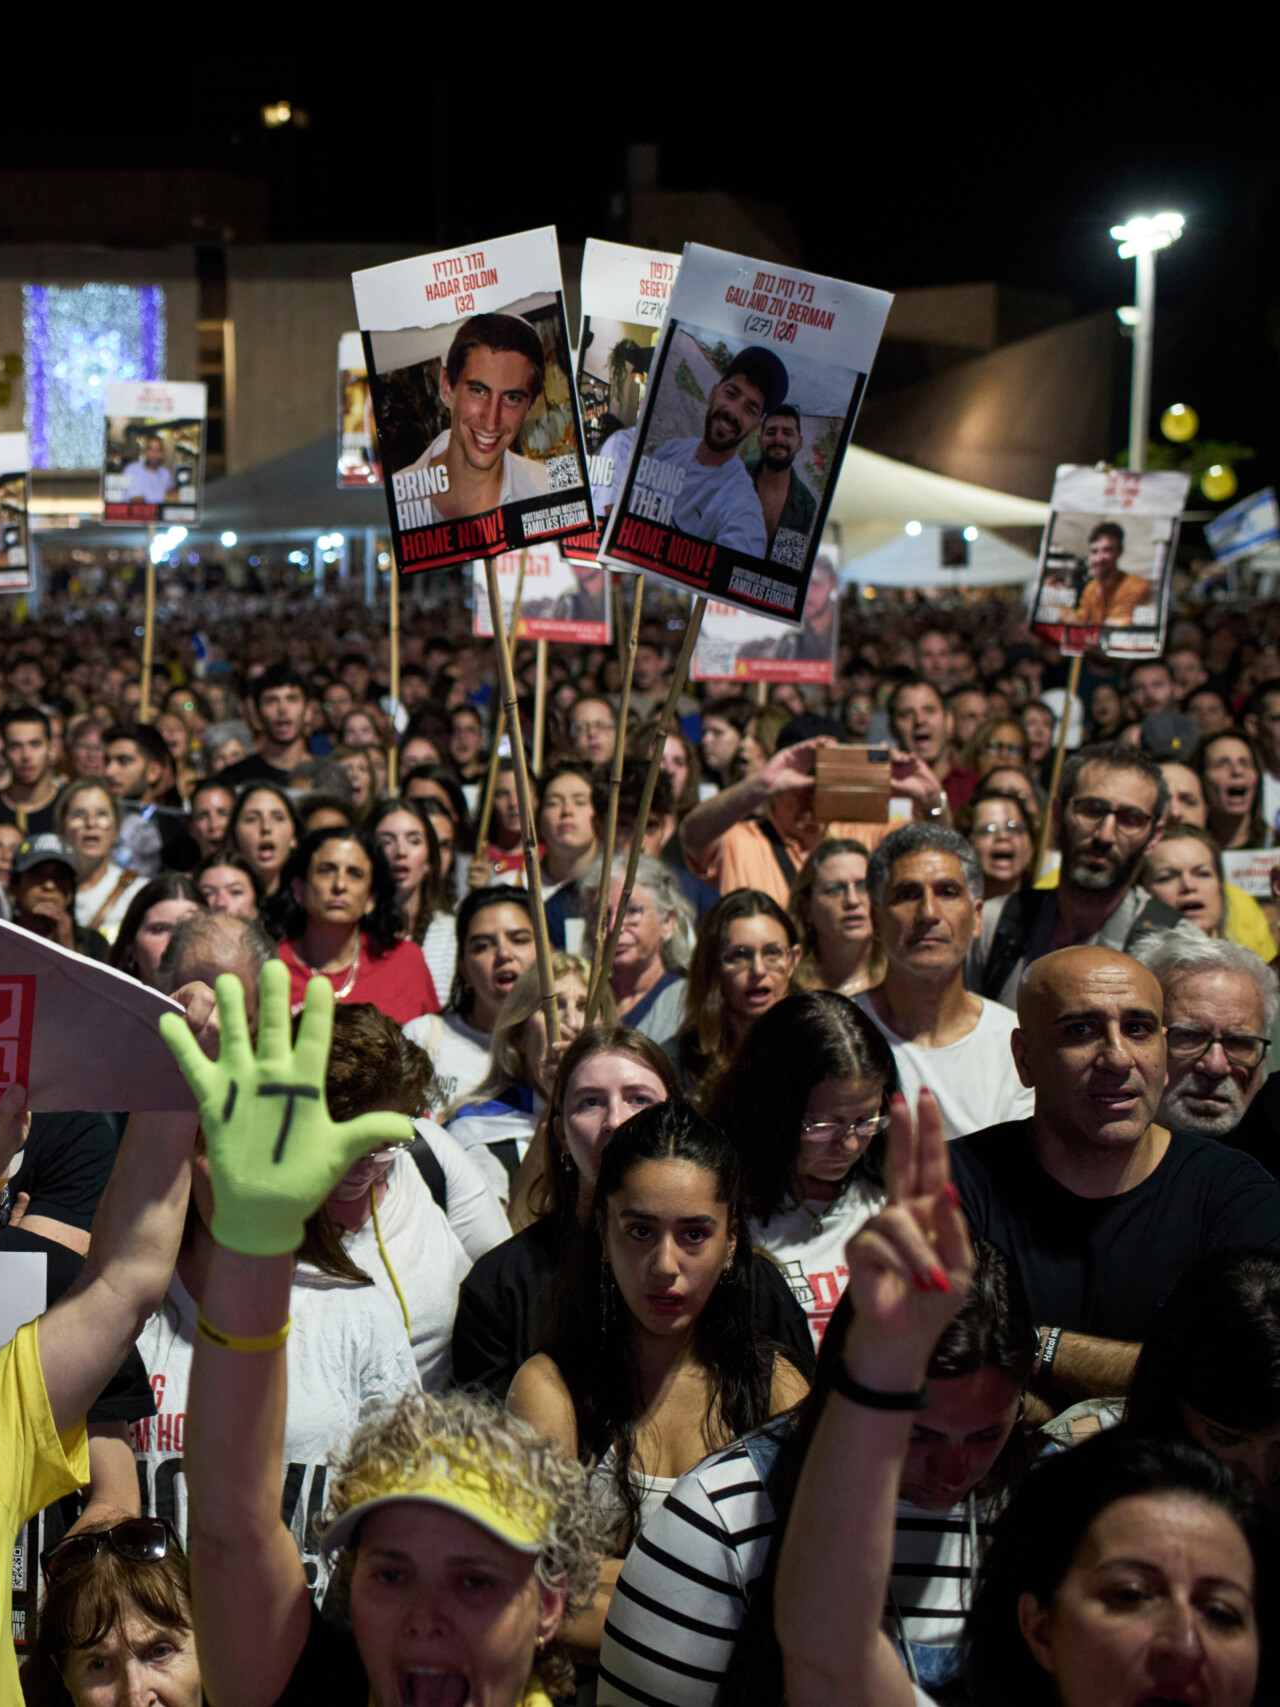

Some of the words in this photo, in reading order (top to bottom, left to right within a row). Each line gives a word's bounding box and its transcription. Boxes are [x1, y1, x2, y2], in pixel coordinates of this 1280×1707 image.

[432, 256, 463, 281] גולדין
[464, 252, 486, 271] הדר
[425, 273, 461, 301] HADAR
[463, 268, 498, 292] GOLDIN
[639, 278, 667, 299] SEGEV
[455, 292, 475, 315] (32)
[725, 285, 746, 308] GALI
[747, 291, 767, 313] AND
[767, 296, 788, 318] ZIV
[787, 301, 835, 331] BERMAN
[743, 313, 774, 335] (27)
[392, 464, 450, 503] BRING
[635, 454, 686, 497] BRING
[396, 498, 435, 532] HIM
[521, 507, 550, 523] HOSTAGES
[549, 504, 561, 516] AND
[561, 500, 587, 515] MISSING
[628, 484, 675, 527] THEM
[400, 525, 455, 563] HOME
[457, 508, 506, 550] NOW!
[523, 515, 559, 536] FAMILIES
[560, 510, 589, 530] FORUM
[616, 516, 668, 560] HOME
[667, 532, 718, 578] NOW!
[729, 576, 764, 600] FAMILIES
[764, 587, 796, 610] FORUM
[1043, 1337, 1057, 1362] Hakol
